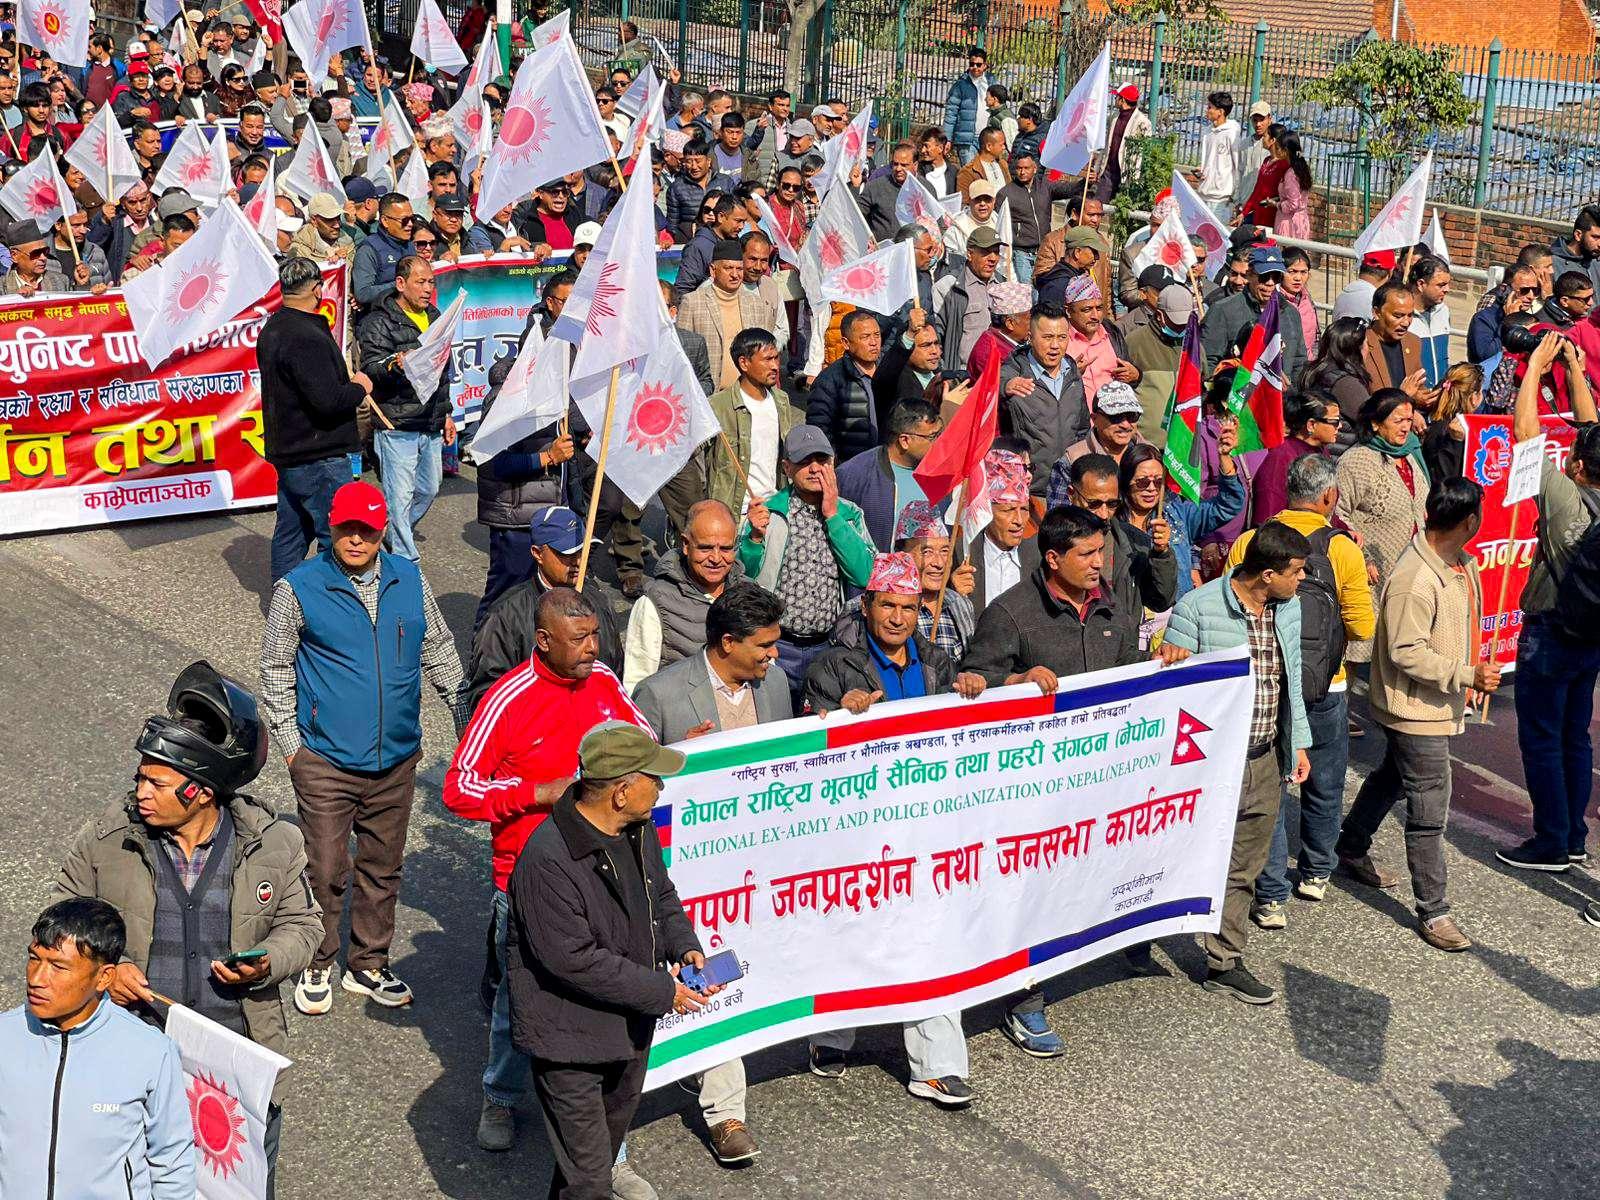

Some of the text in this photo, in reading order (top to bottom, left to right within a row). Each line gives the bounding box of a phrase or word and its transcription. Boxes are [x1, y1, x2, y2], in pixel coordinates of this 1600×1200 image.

[38, 390, 75, 420] रक्षा
[78, 387, 94, 415] र
[92, 414, 219, 475] तथा
[681, 716, 1166, 826] नेपाल राष्ट्रिय भूतपूर्व सैनिक तथा प्रहरी संगठन (नेपोन)
[851, 750, 857, 760] र
[861, 740, 900, 758] भौगोलिक
[952, 729, 965, 746] पूर्व
[678, 752, 1161, 862] NATIONAL EX-ARMY AND POLICE ORGANIZATION OF NEPAL(NEAPON)
[770, 845, 916, 918] जनप्रदर्शन
[931, 841, 984, 896] तथा
[997, 818, 1097, 877] जनसभा
[1106, 786, 1203, 847] कार्यक्रम
[723, 989, 743, 1007] बजे
